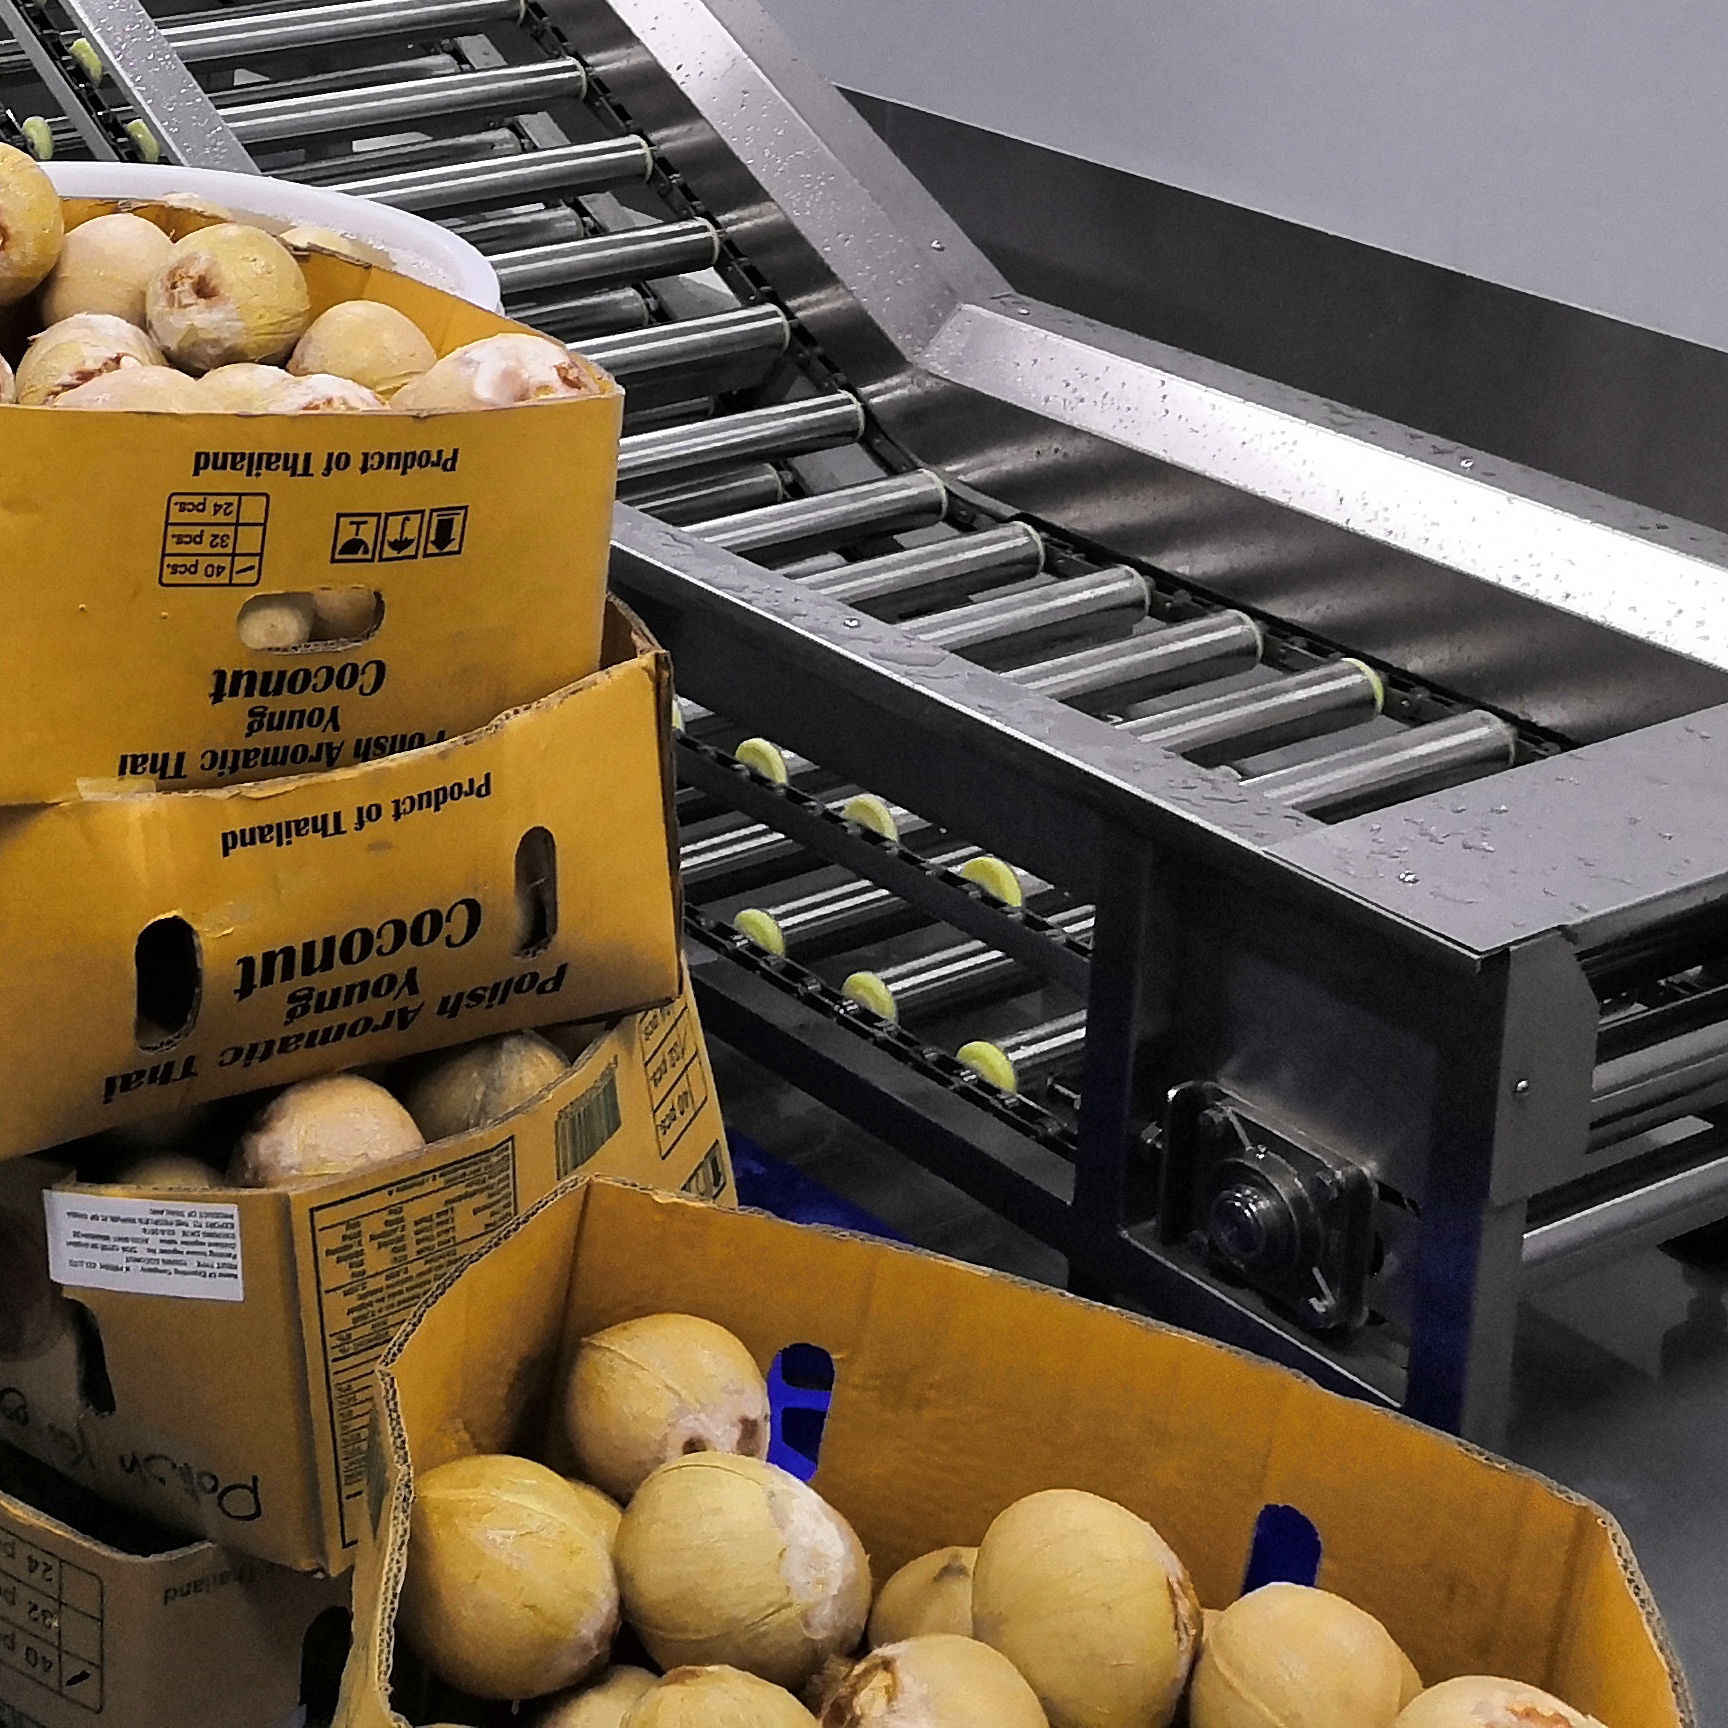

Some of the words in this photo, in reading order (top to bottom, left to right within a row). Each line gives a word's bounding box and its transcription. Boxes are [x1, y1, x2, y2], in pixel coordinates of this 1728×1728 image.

[191, 450, 312, 480] Thailand
[319, 452, 352, 478] of
[360, 447, 460, 475] Product
[213, 501, 234, 516] 24
[209, 533, 230, 548] 32
[204, 563, 226, 578] 40
[209, 659, 387, 705] Coconut
[245, 705, 341, 738] Young
[118, 750, 187, 780] Thai
[199, 738, 343, 774] Aromatic
[392, 772, 492, 823] Product
[221, 810, 347, 859] Thailand
[353, 803, 384, 834] of
[234, 897, 483, 1001] Coconut
[283, 966, 420, 1026] Young
[435, 962, 569, 1018] Polish
[218, 999, 425, 1069] Aromatic
[102, 1055, 198, 1105] Thai
[27, 1553, 54, 1584] 24
[24, 1645, 54, 1673] 40
